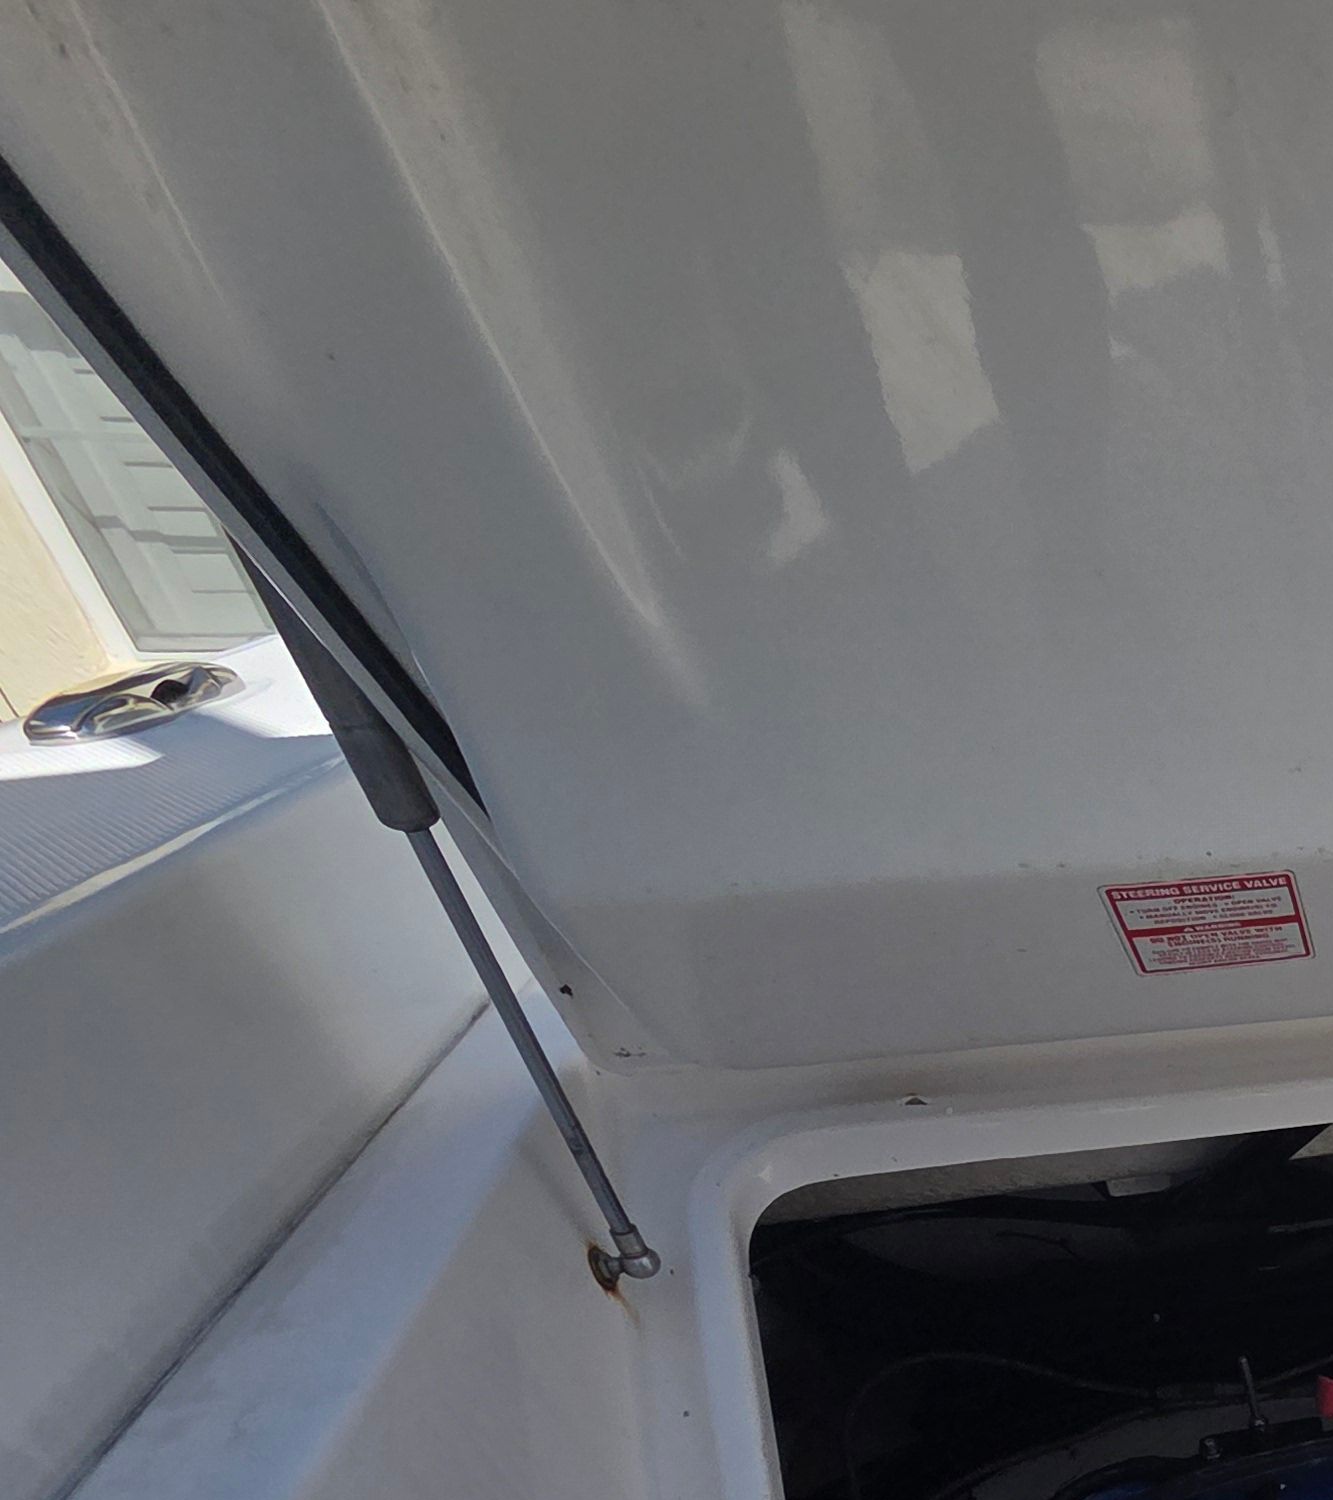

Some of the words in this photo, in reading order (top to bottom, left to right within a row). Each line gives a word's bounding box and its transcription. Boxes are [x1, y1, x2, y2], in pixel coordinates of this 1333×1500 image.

[1111, 886, 1180, 899] STEERING
[1183, 881, 1241, 895] SERVICE
[1244, 877, 1287, 889] VALVE
